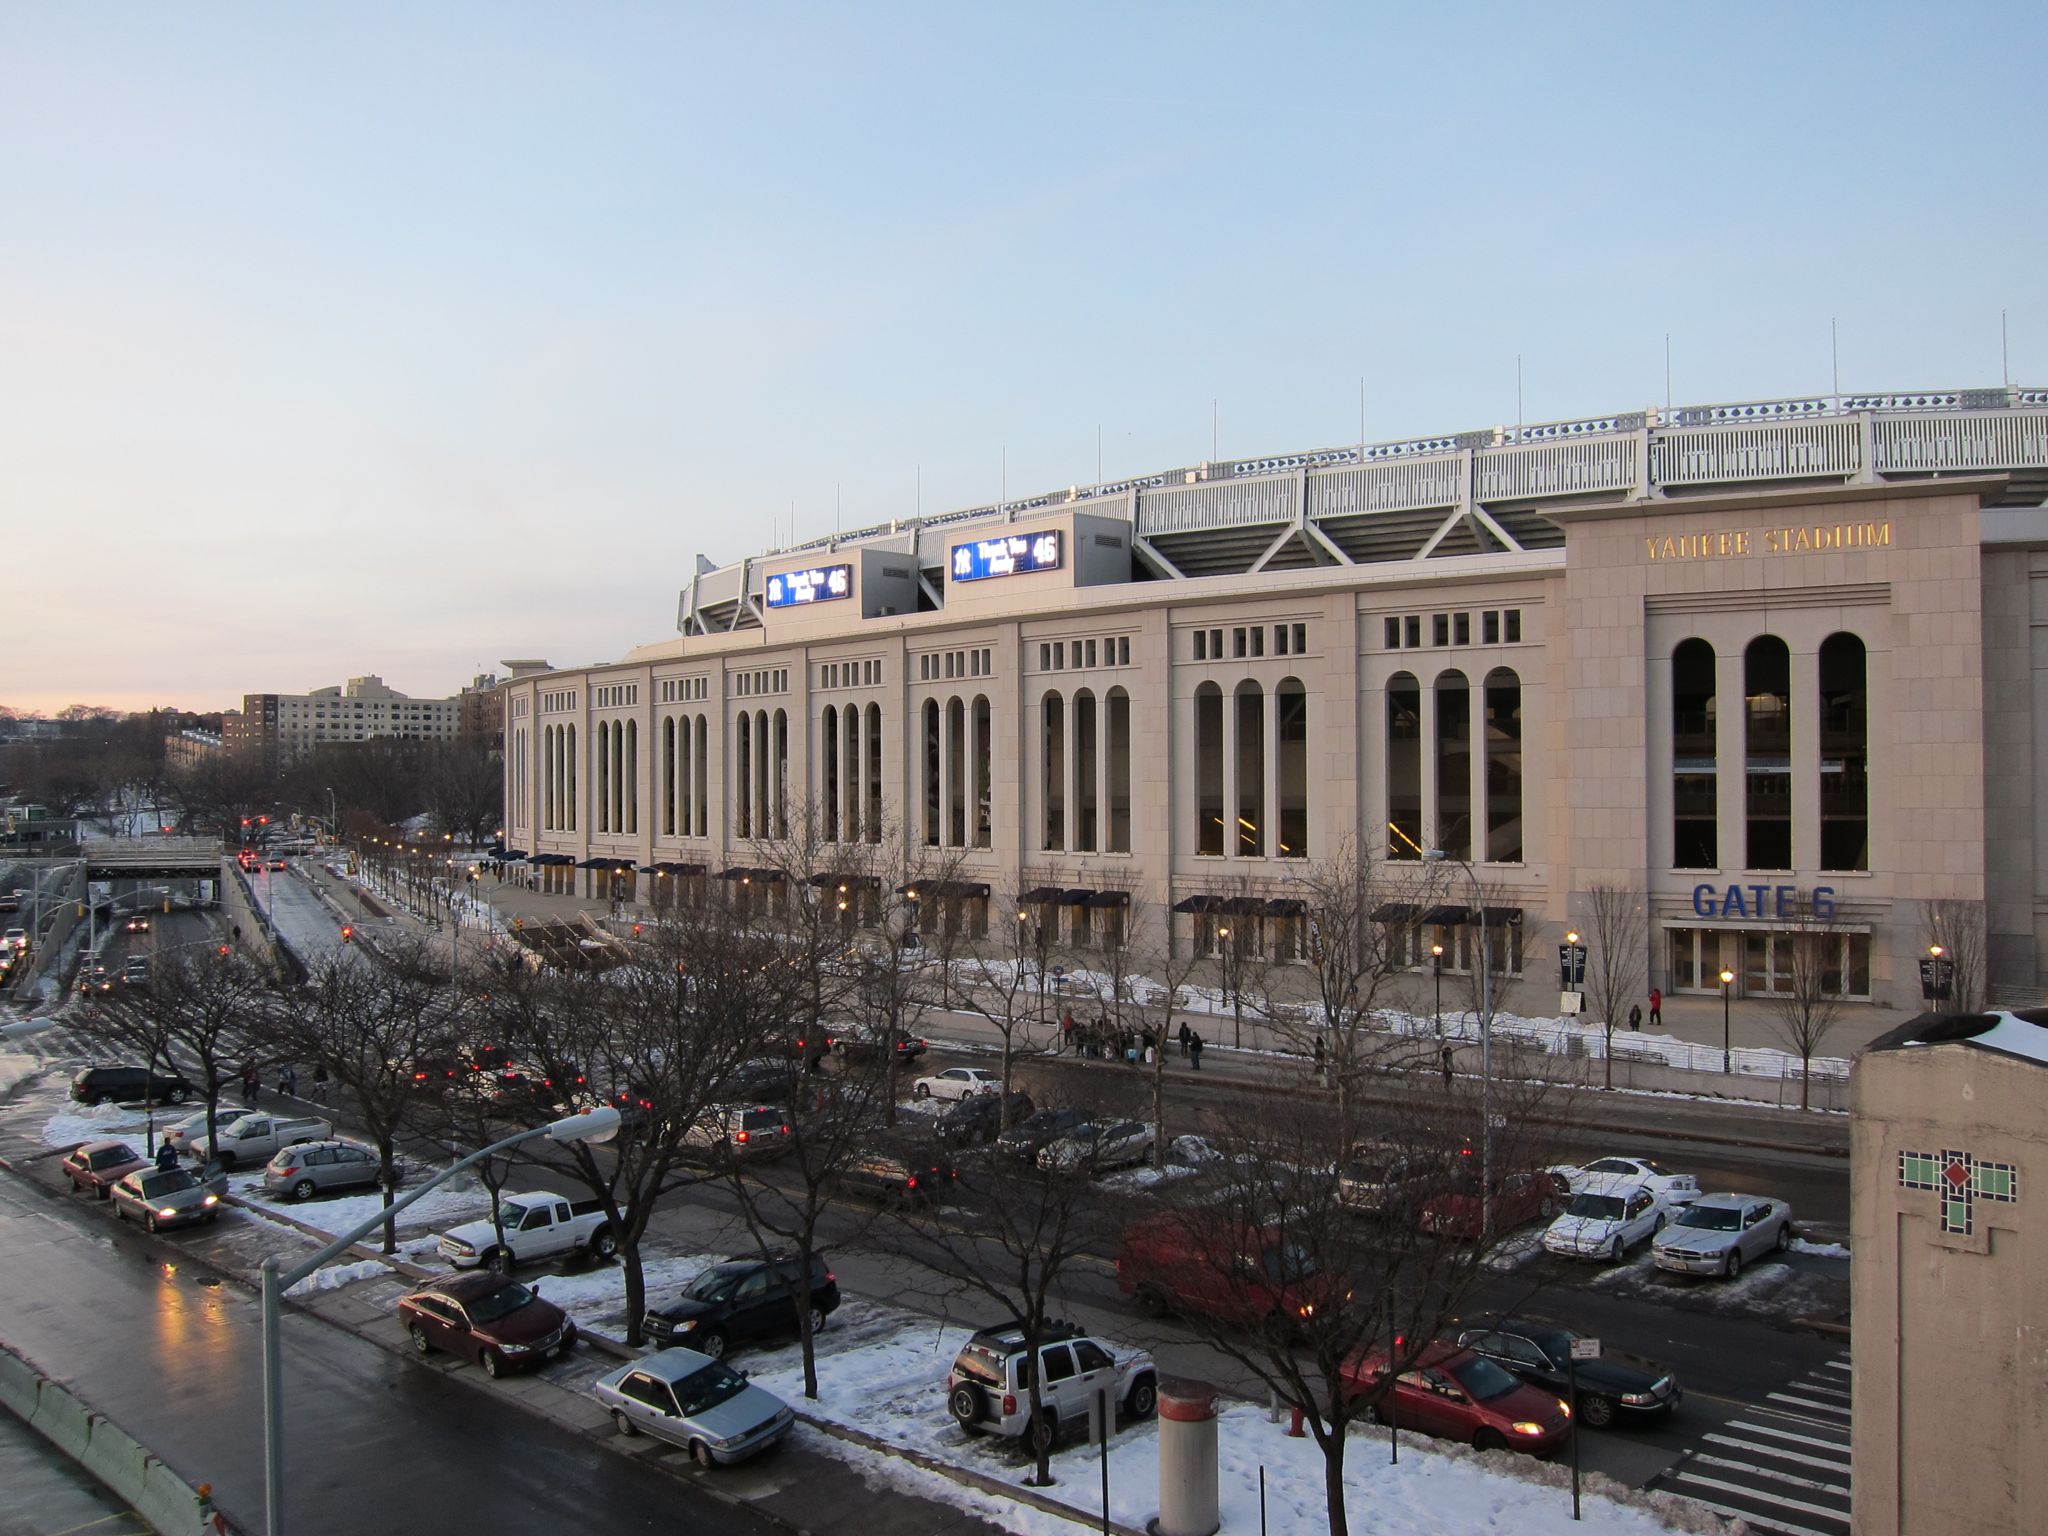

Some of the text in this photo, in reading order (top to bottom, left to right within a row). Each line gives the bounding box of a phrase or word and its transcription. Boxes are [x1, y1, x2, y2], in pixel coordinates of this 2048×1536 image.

[1033, 536, 1056, 563] 46
[1644, 521, 1891, 560] YANKEE STADIUM
[828, 569, 846, 593] 46
[1693, 884, 1835, 918] GATE 6
